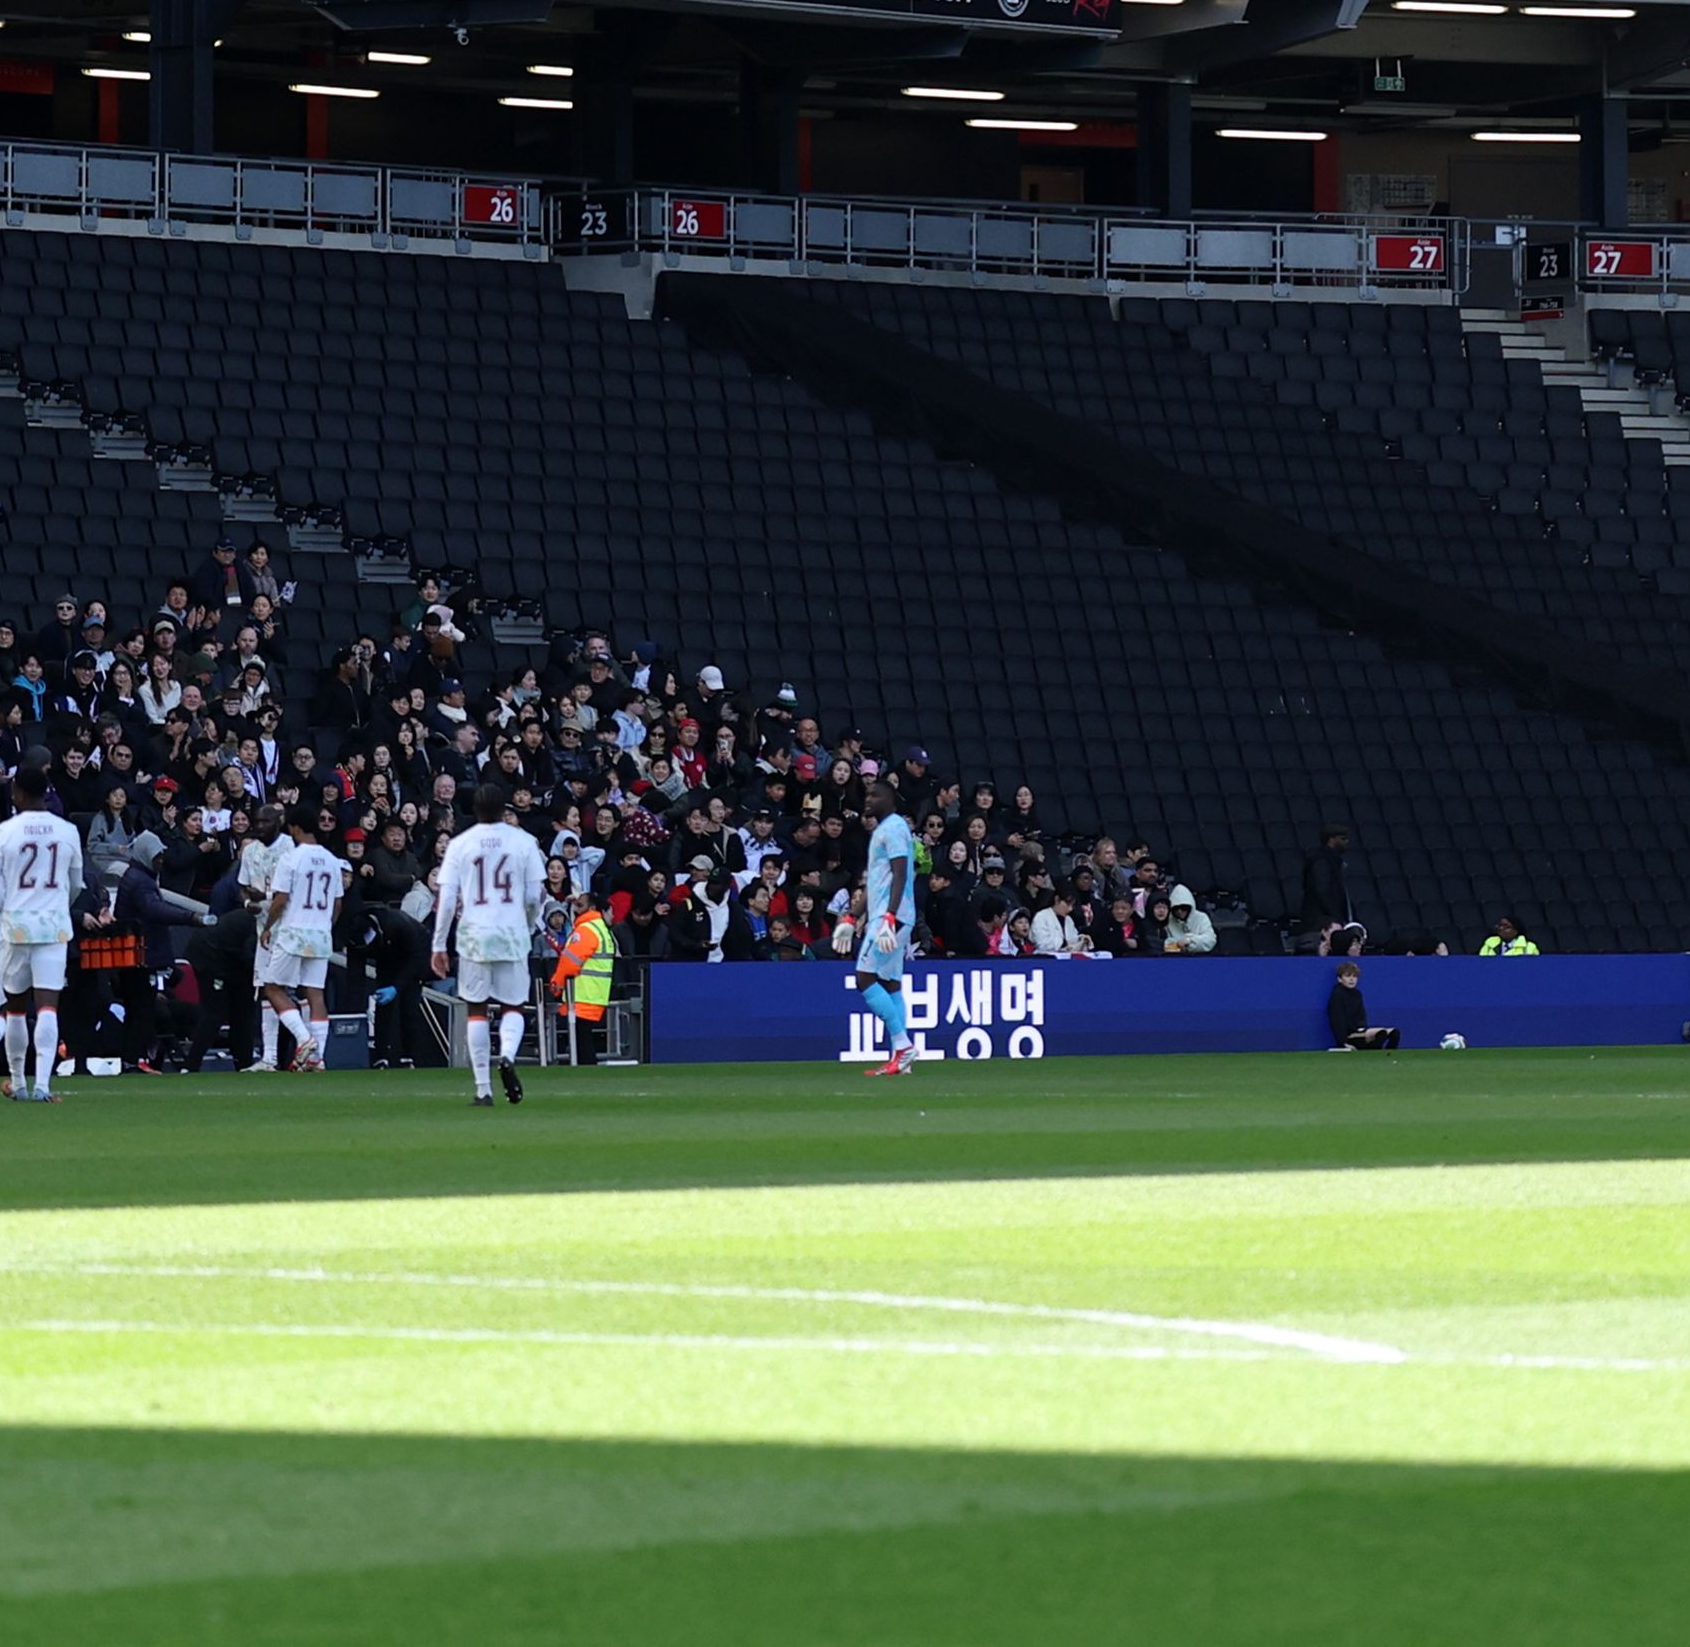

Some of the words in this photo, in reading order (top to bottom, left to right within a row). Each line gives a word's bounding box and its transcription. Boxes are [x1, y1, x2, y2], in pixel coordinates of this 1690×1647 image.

[490, 197, 514, 223] 26
[676, 210, 699, 235] 26
[581, 211, 607, 236] 23
[1409, 246, 1438, 269] 27
[1539, 254, 1558, 277] 23
[1593, 251, 1622, 274] 27
[17, 841, 60, 889] 21
[302, 871, 332, 910] 13
[473, 854, 514, 905] 14
